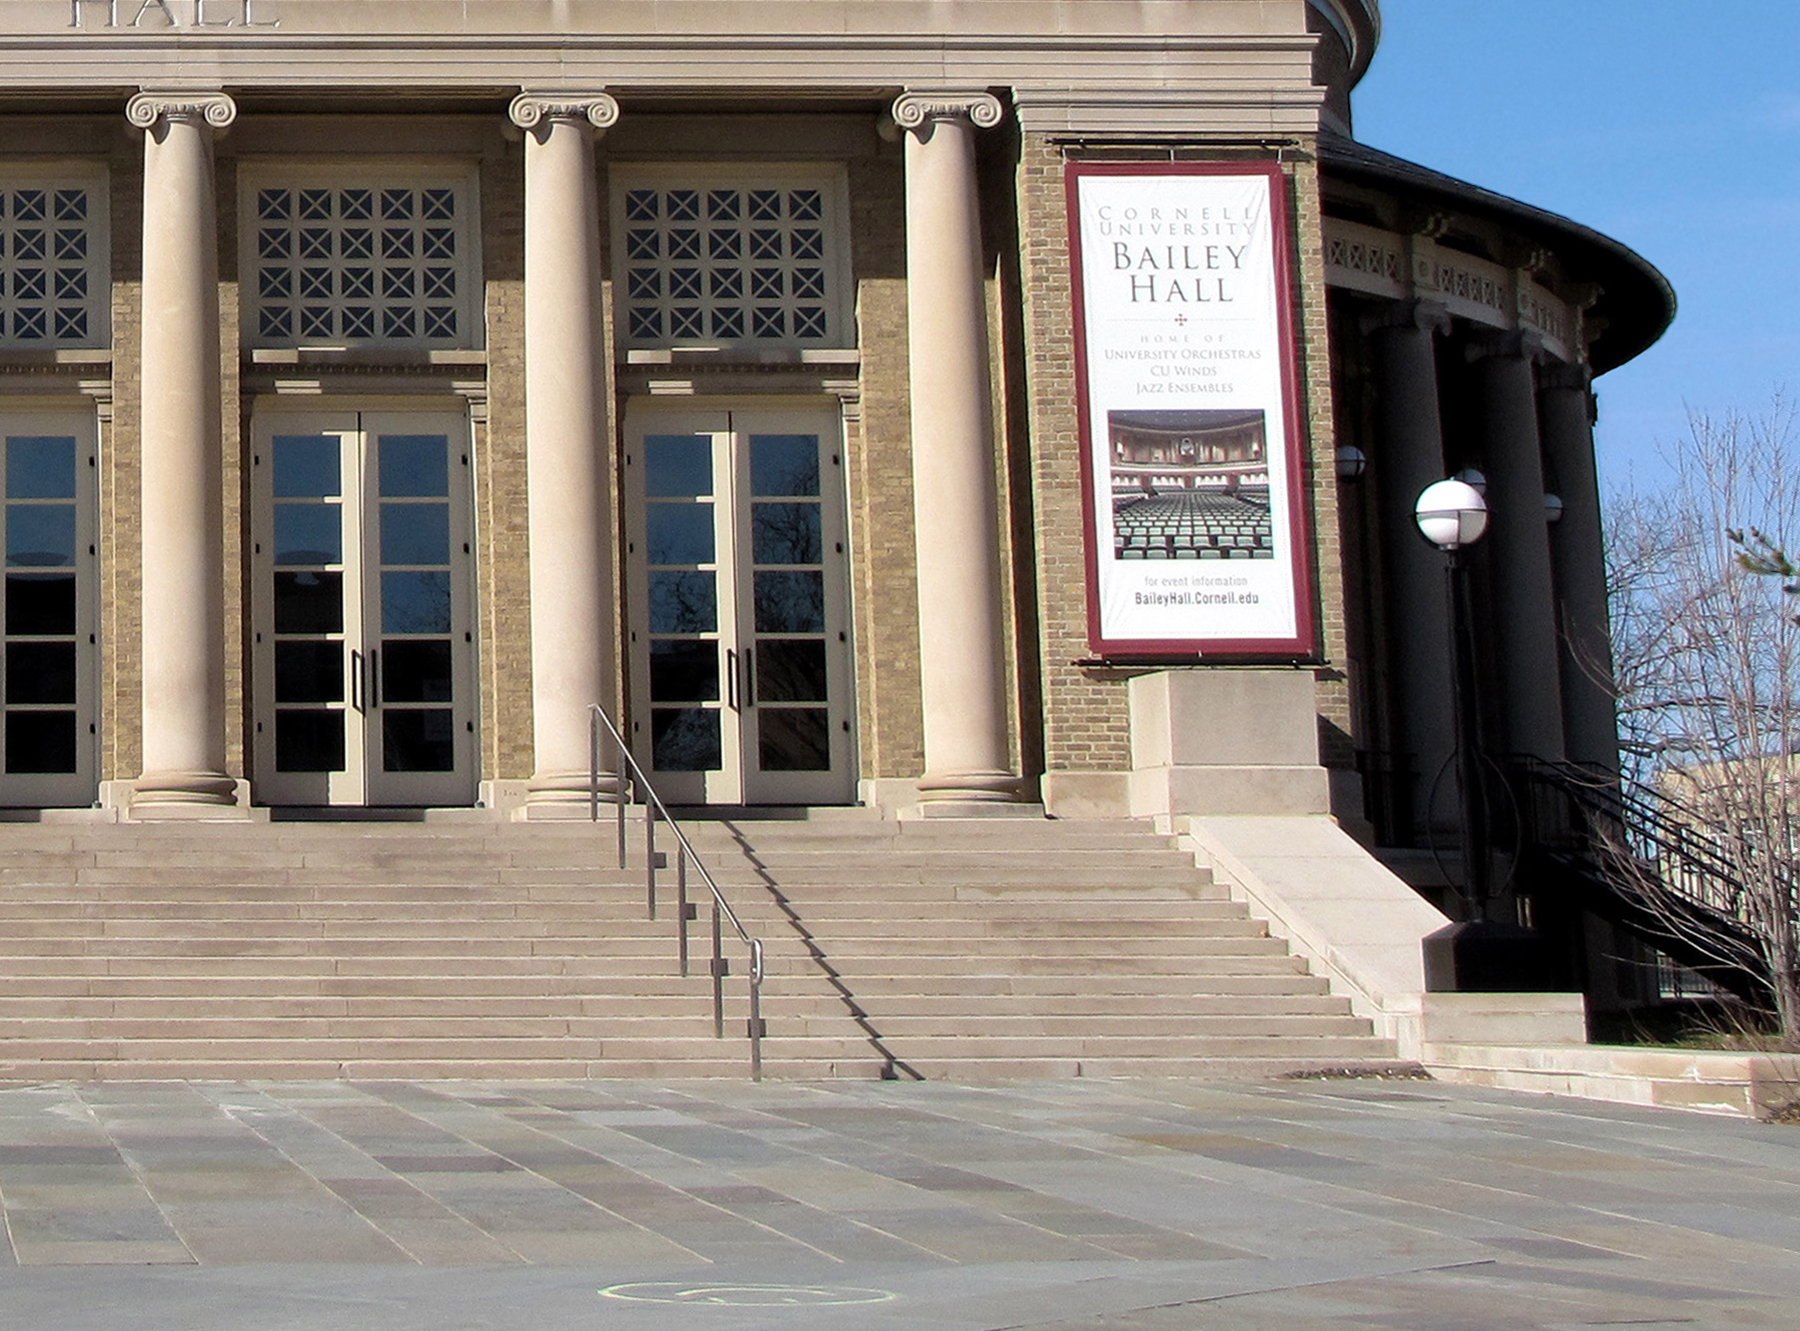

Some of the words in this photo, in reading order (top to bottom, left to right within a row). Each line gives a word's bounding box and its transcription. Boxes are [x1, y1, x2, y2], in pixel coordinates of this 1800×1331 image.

[1098, 205, 1253, 221] CORNELL
[1100, 221, 1256, 237] UNIVERSITY
[1112, 240, 1248, 271] BAILEY
[1129, 273, 1234, 303] HALL
[1140, 334, 1191, 343] HOME
[1203, 334, 1225, 343] OF
[1104, 348, 1178, 360] UNIVERSITY
[1180, 348, 1262, 361] ORCHESTRAS
[1149, 365, 1171, 377] CU
[1173, 365, 1218, 377] WINDS
[1136, 382, 1165, 395] JAZZ
[1167, 382, 1235, 394] ENSEMBLES
[1144, 575, 1158, 588] for
[1160, 576, 1189, 588] event
[1191, 575, 1249, 588] information
[1135, 591, 1260, 607] BaileyHall.Cornell.edu
